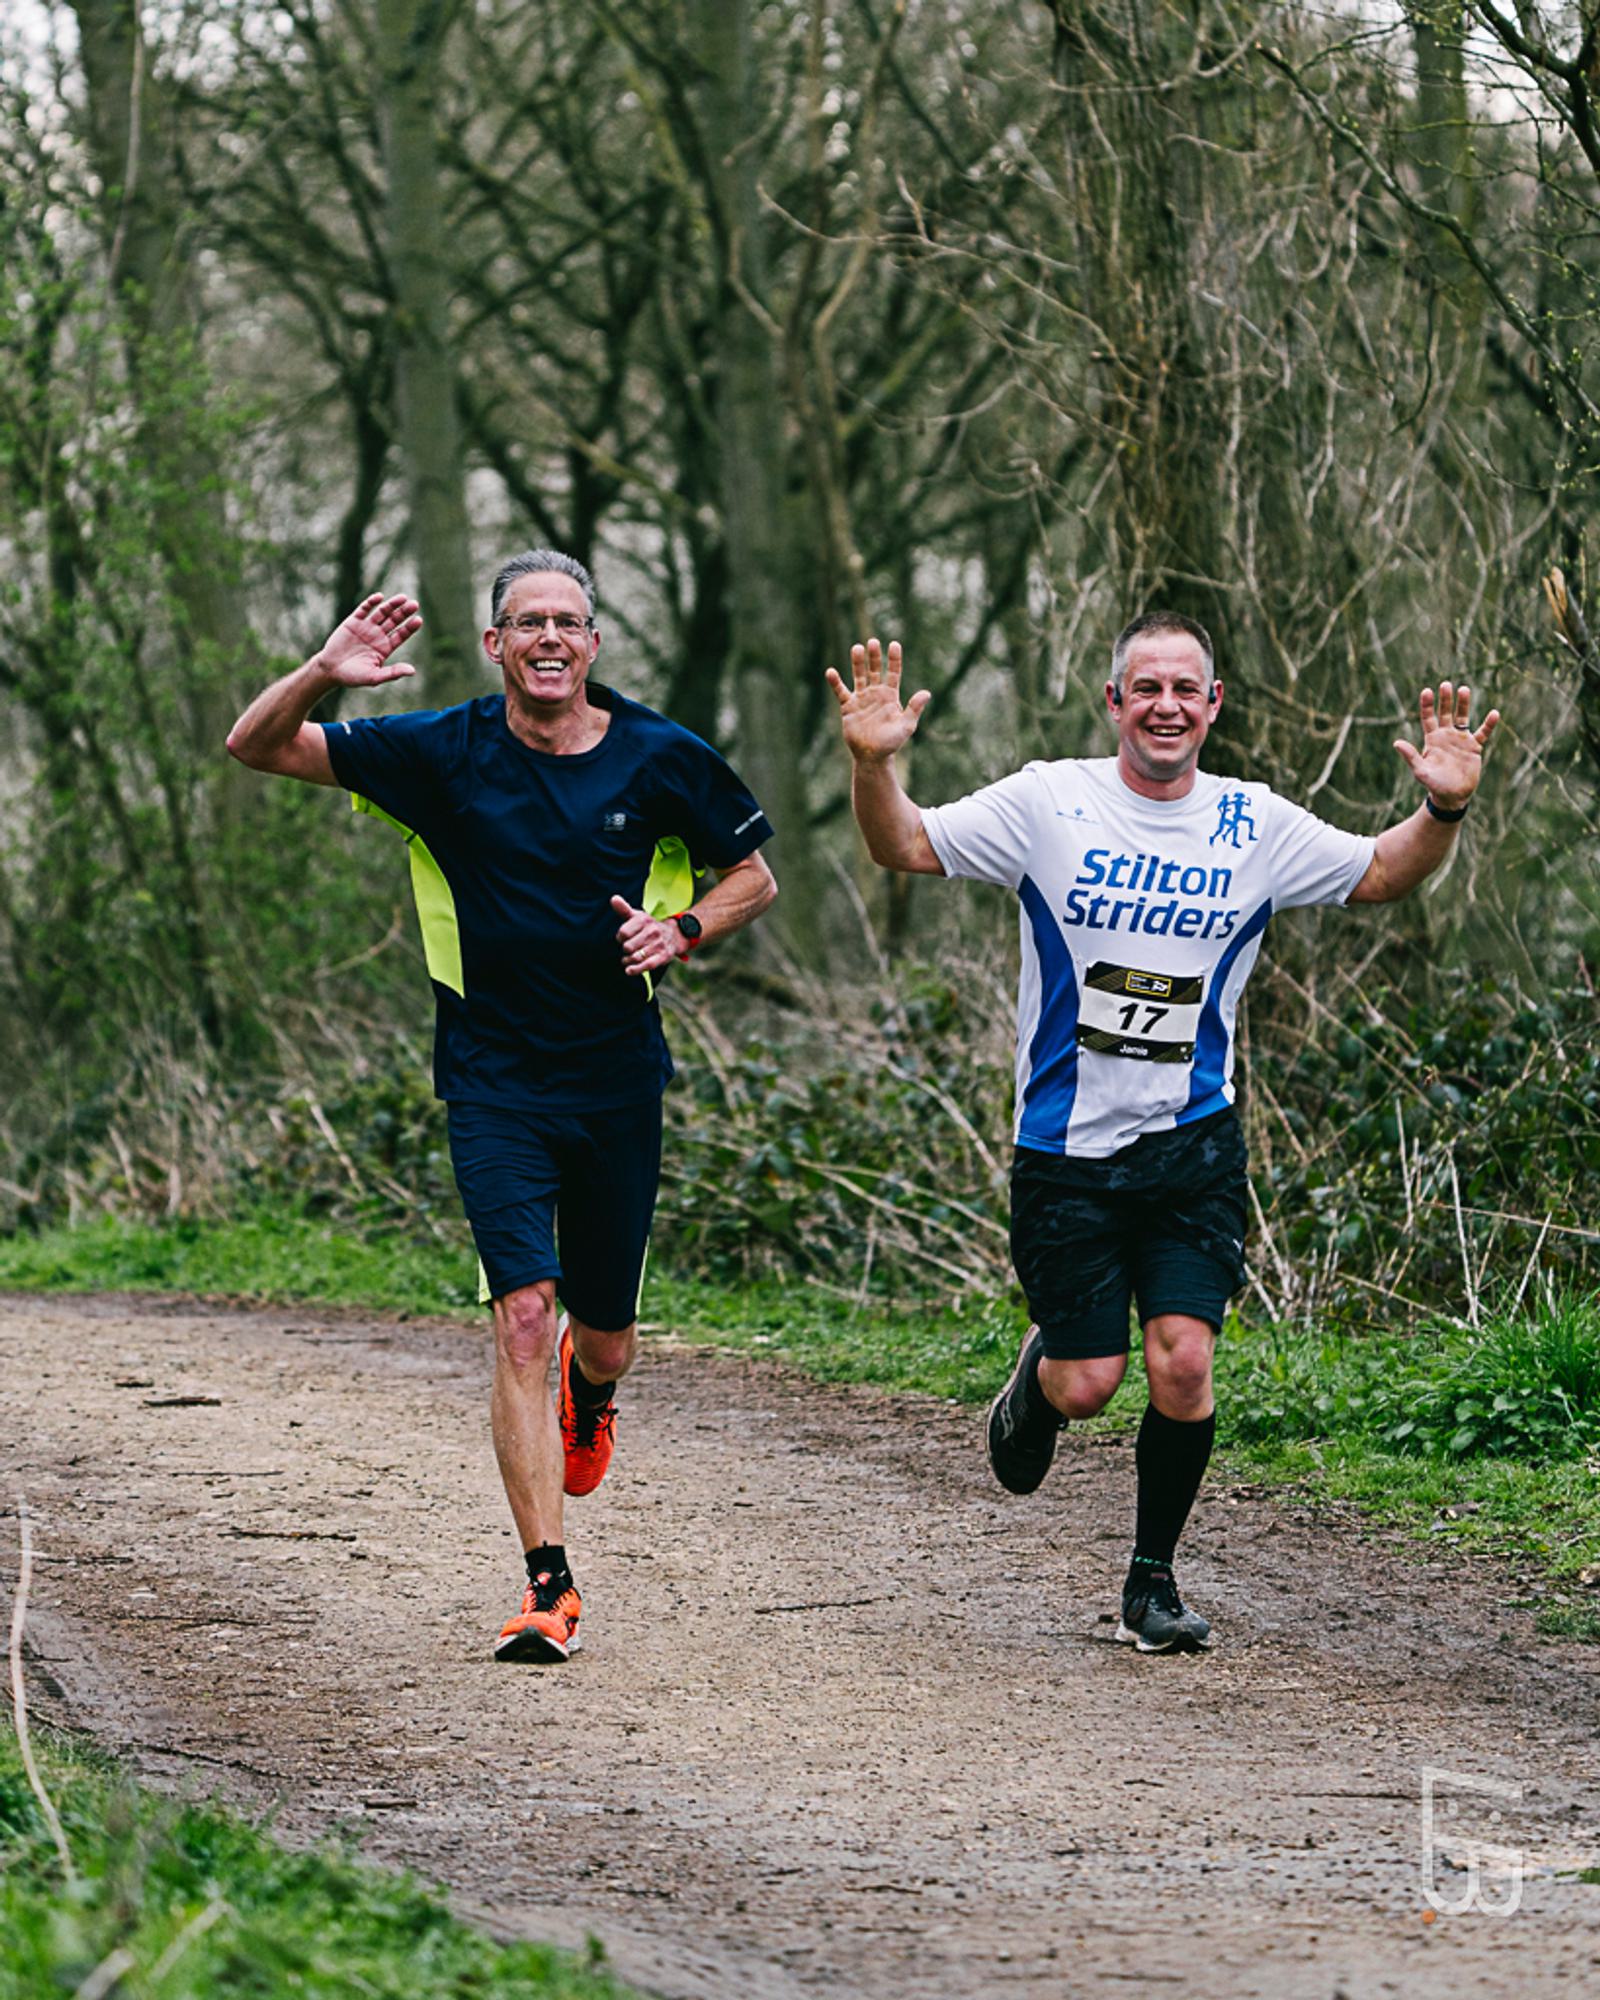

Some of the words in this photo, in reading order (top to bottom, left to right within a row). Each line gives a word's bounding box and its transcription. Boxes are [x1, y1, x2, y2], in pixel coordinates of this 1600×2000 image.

[1075, 848, 1232, 898] Stilton
[1063, 888, 1240, 940] Striders
[1118, 1002, 1170, 1034] 17
